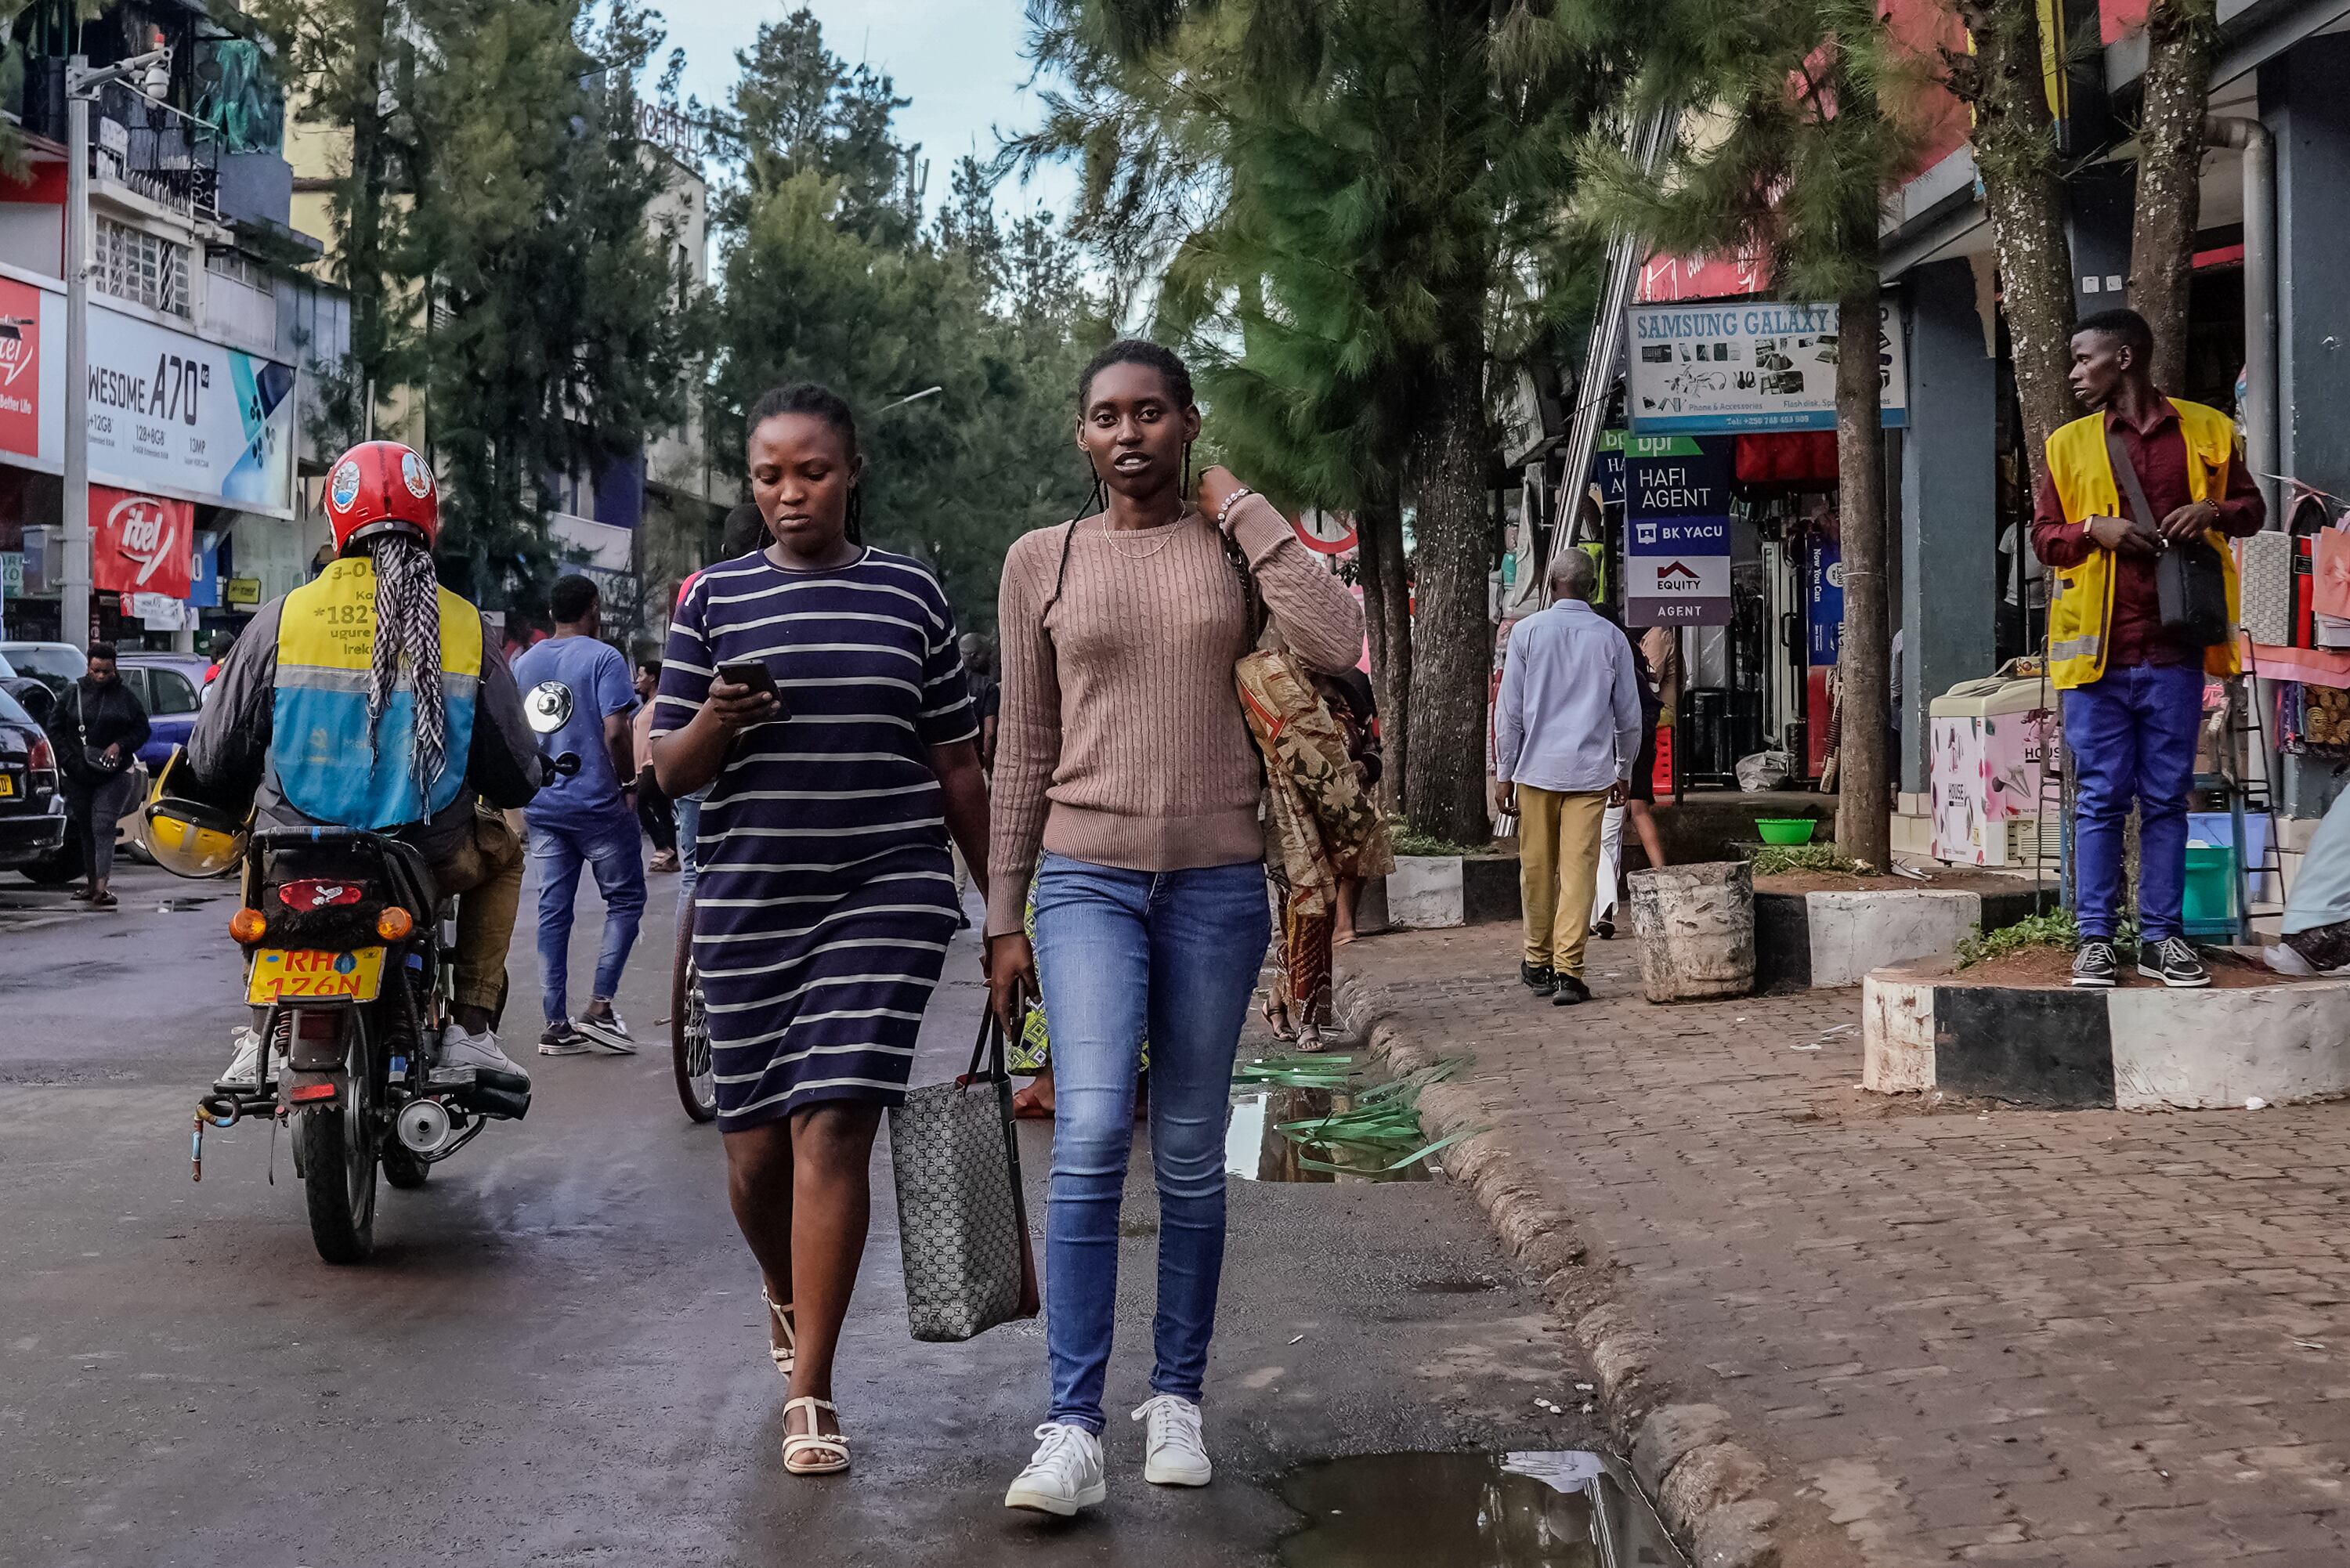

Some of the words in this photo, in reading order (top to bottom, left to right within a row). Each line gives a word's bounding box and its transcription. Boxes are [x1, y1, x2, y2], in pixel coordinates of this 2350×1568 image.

[1637, 313, 1738, 338] SAMSUNG
[1744, 309, 1828, 334] GALAXY
[89, 364, 145, 414] WESOME
[149, 352, 197, 426] A70
[190, 437, 206, 455] 13MP
[1640, 468, 1686, 487] HAFI
[1642, 488, 1711, 509] AGENT
[122, 508, 163, 551] itel
[1662, 526, 1680, 540] BK
[1684, 526, 1723, 538] YACU
[1813, 568, 1822, 584] You
[1658, 580, 1701, 592] EQUITY
[1658, 605, 1702, 617] AGENT
[331, 629, 371, 641] ugure
